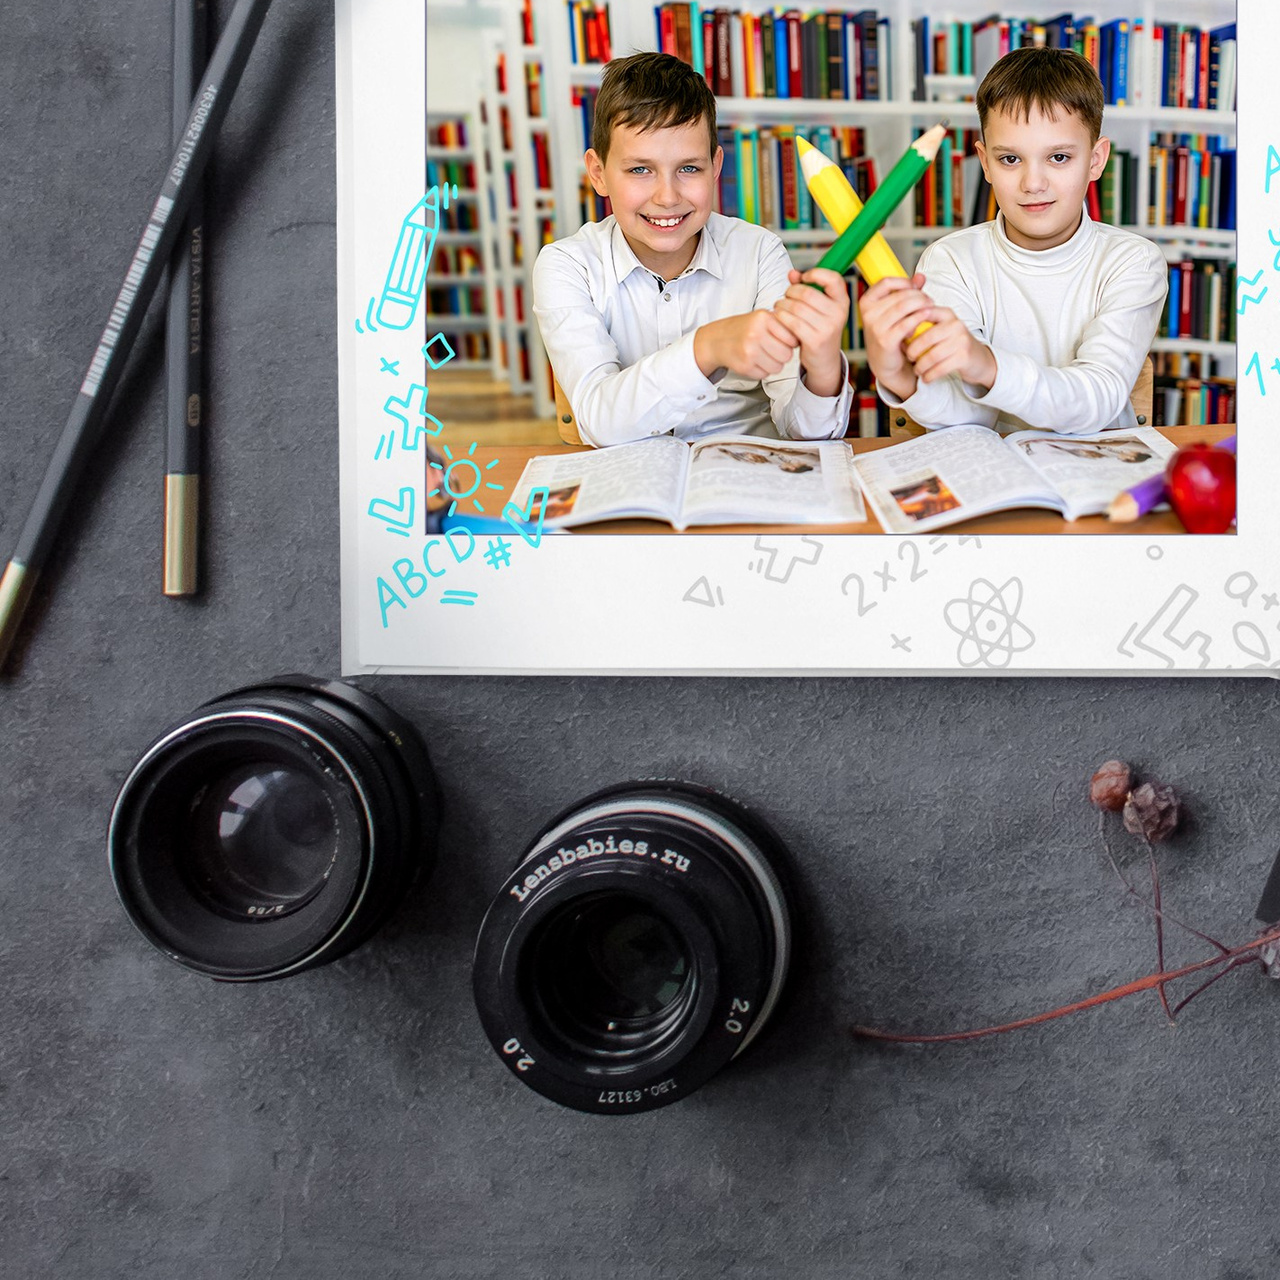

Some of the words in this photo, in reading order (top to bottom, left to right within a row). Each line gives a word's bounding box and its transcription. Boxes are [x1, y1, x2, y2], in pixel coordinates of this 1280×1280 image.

[377, 526, 475, 628] ABCD
[510, 835, 692, 902] Lensbabies.ru
[725, 997, 750, 1034] 2.0
[503, 1037, 536, 1071] 2.0
